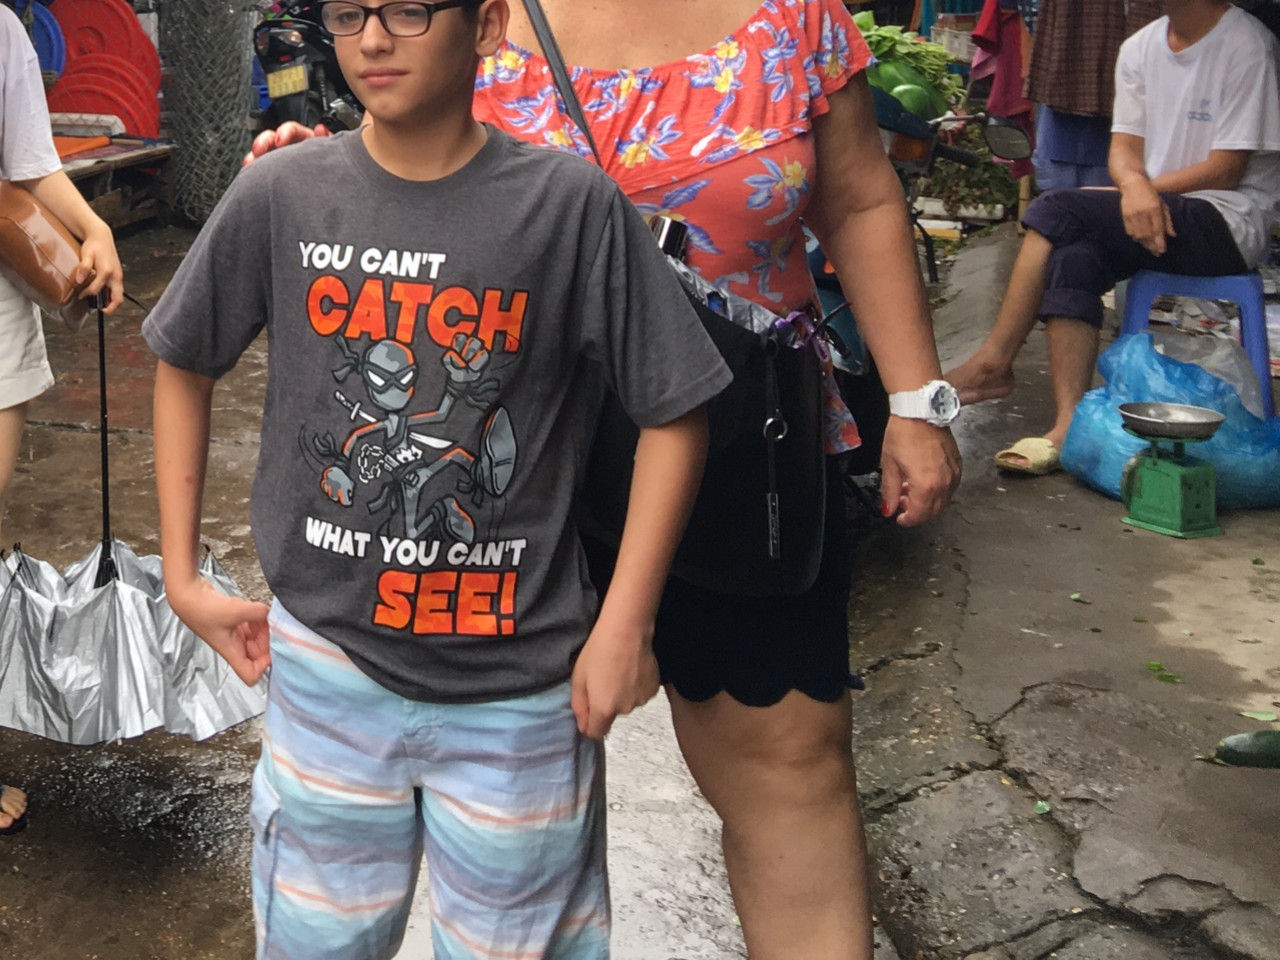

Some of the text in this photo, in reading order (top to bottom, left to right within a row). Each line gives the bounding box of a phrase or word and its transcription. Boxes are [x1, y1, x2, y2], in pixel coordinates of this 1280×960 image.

[298, 242, 447, 280] YOU CAN'T
[306, 275, 528, 352] CATCH
[306, 517, 527, 566] WHAT YOU CAN'T
[373, 570, 517, 636] SEE!
